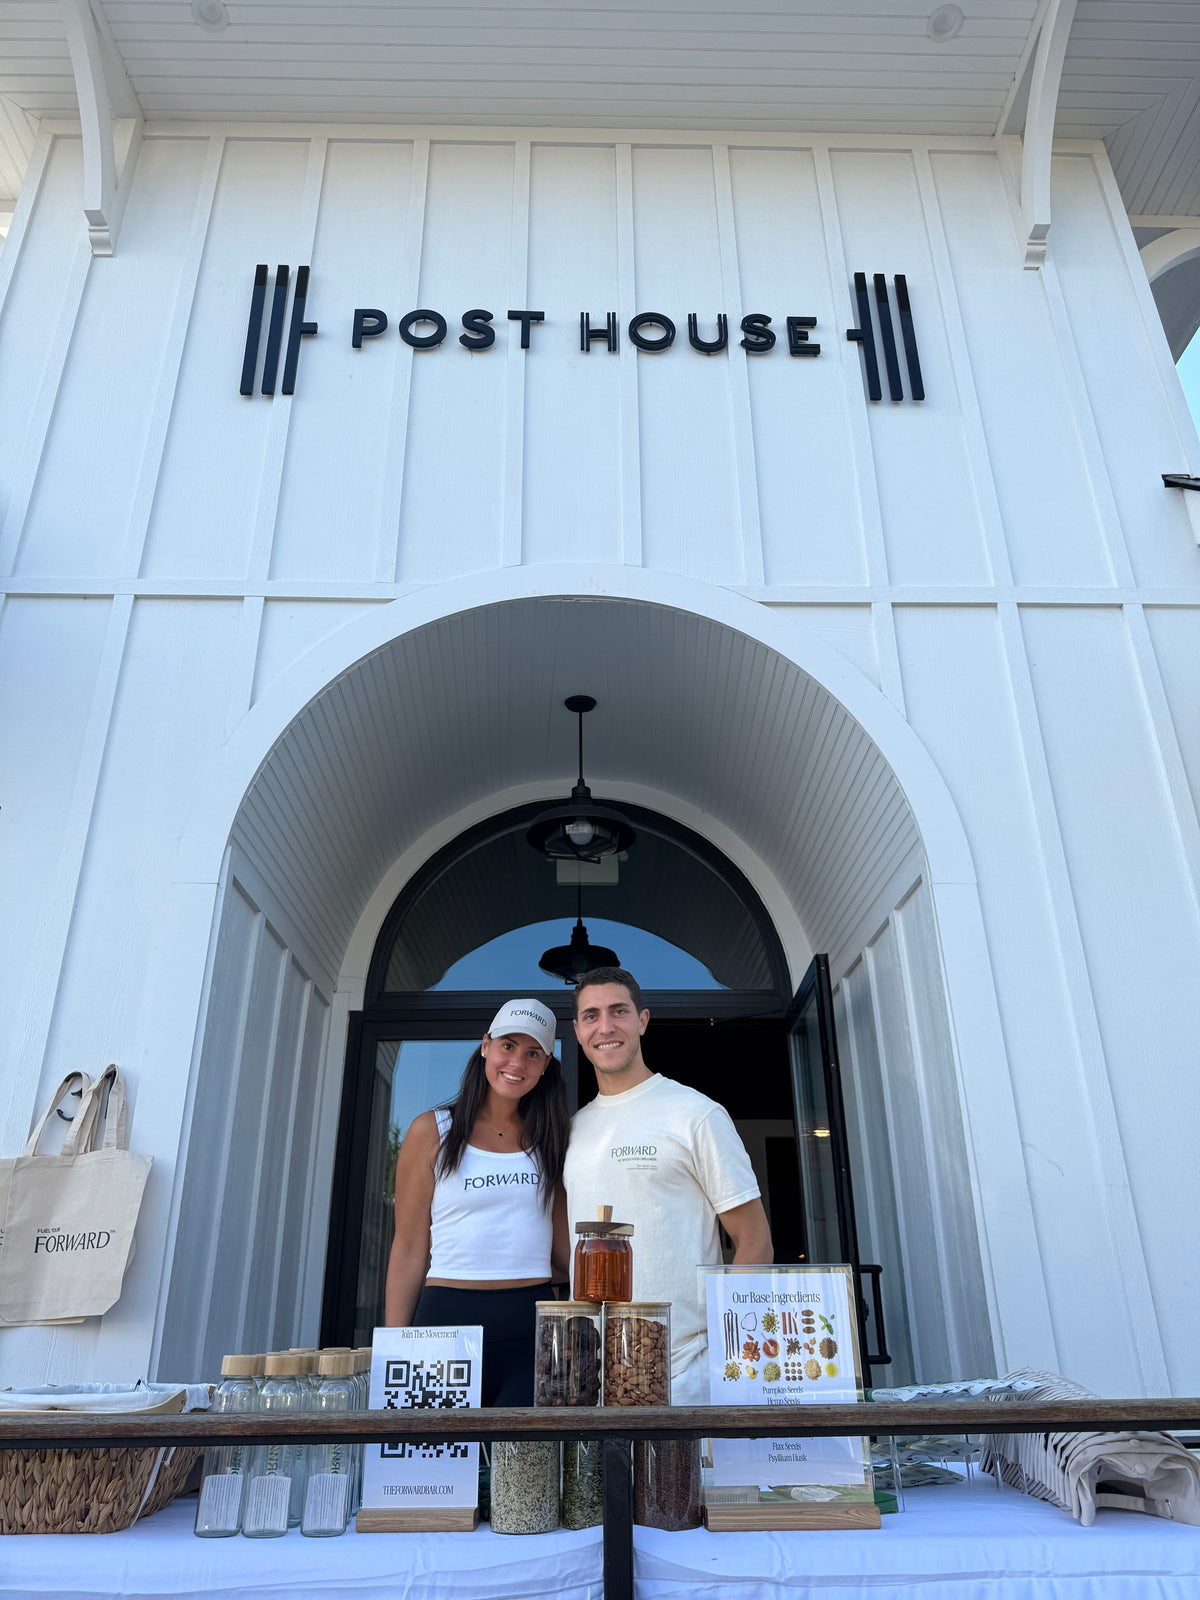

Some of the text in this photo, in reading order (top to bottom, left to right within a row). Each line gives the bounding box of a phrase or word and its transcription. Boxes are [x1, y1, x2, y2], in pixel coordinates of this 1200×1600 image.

[352, 308, 821, 357] POST HOUSE
[510, 1009, 548, 1027] FORWARD
[610, 1145, 658, 1158] FORWARD
[464, 1172, 540, 1190] FORWARD
[732, 1291, 821, 1305] Our Base Ingredients
[401, 1329, 459, 1339] Join The Movement!
[762, 1385, 804, 1395] Pumpkin Seeds
[783, 1396, 801, 1406] Seeds
[772, 1442, 802, 1451] Flax Seeds
[768, 1453, 808, 1463] Psyllium Husk
[383, 1485, 454, 1496] THEFORWARDBAR.COM
